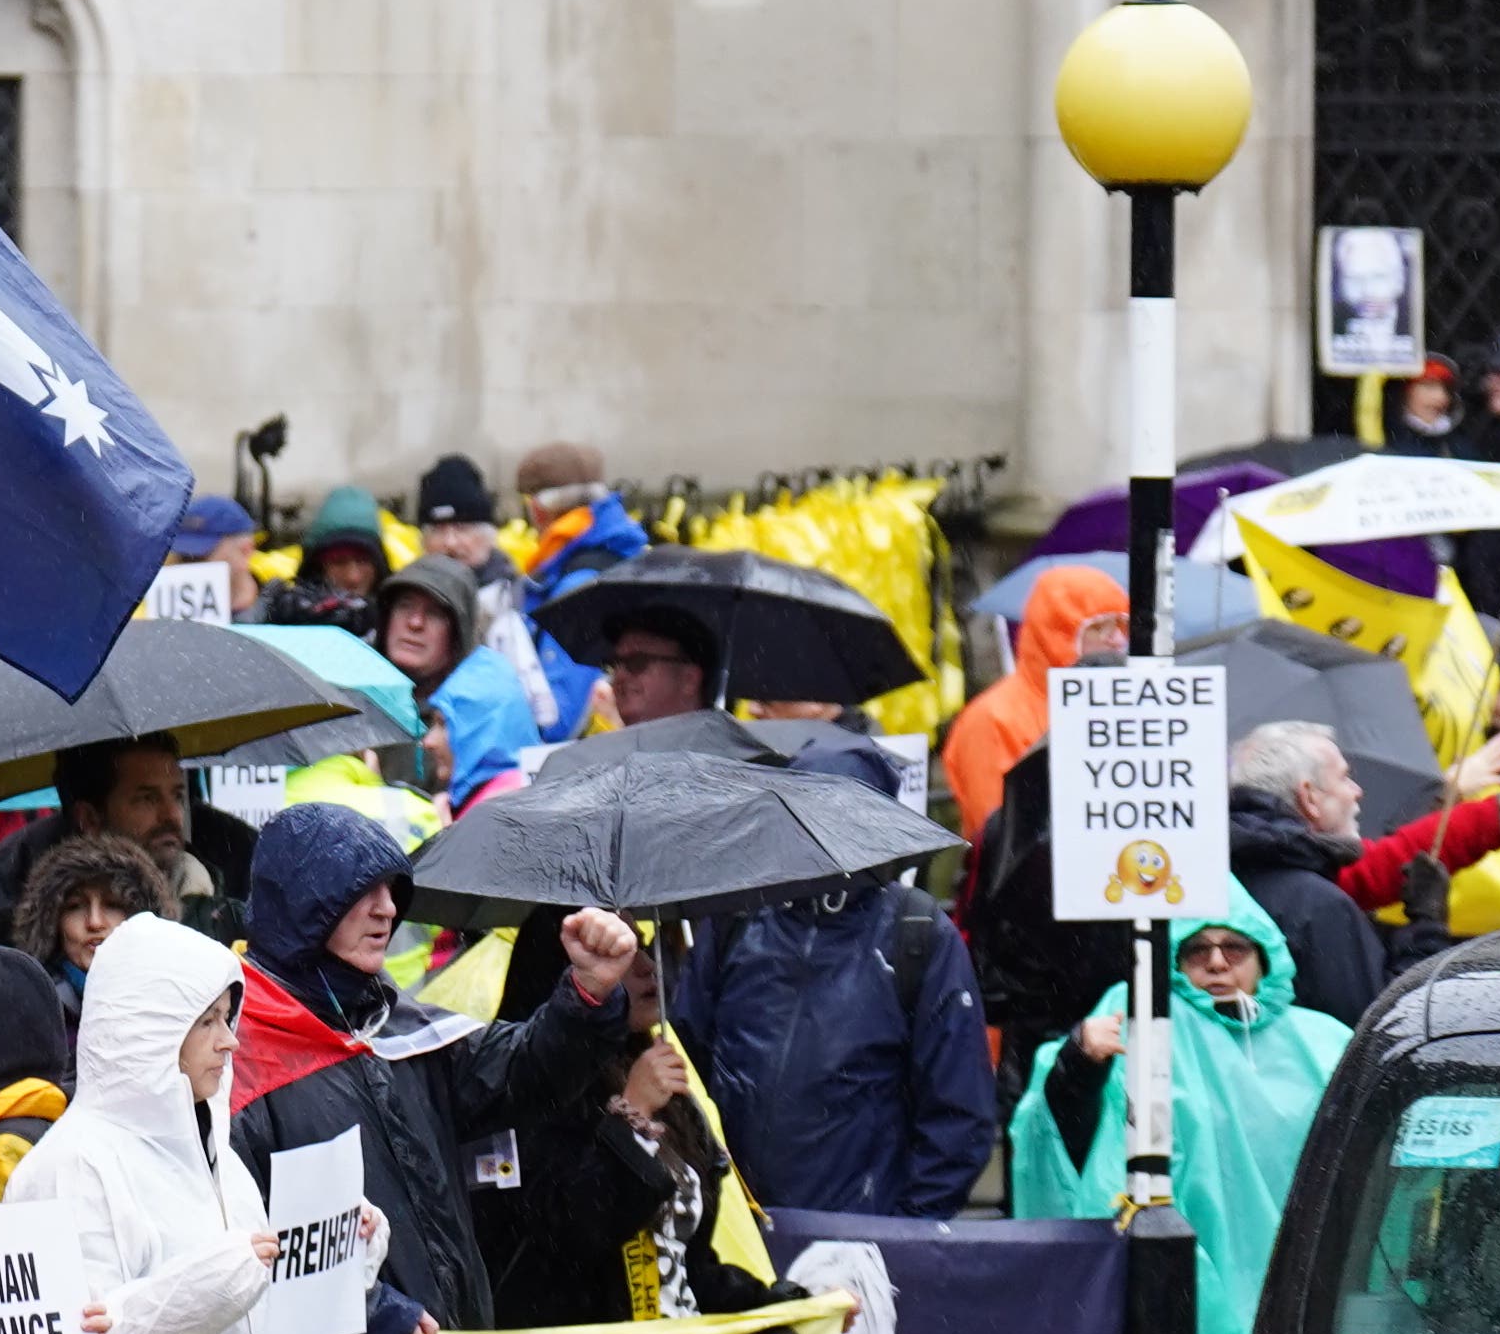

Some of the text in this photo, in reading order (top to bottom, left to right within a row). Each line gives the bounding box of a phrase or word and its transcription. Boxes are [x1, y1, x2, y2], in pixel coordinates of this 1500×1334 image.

[157, 581, 220, 620] USA
[1062, 678, 1214, 707] PLEASE
[1087, 719, 1189, 748] BEEP
[1084, 760, 1193, 789] YOUR
[1085, 801, 1195, 830] HORN
[271, 1205, 361, 1284] FREIHEIT
